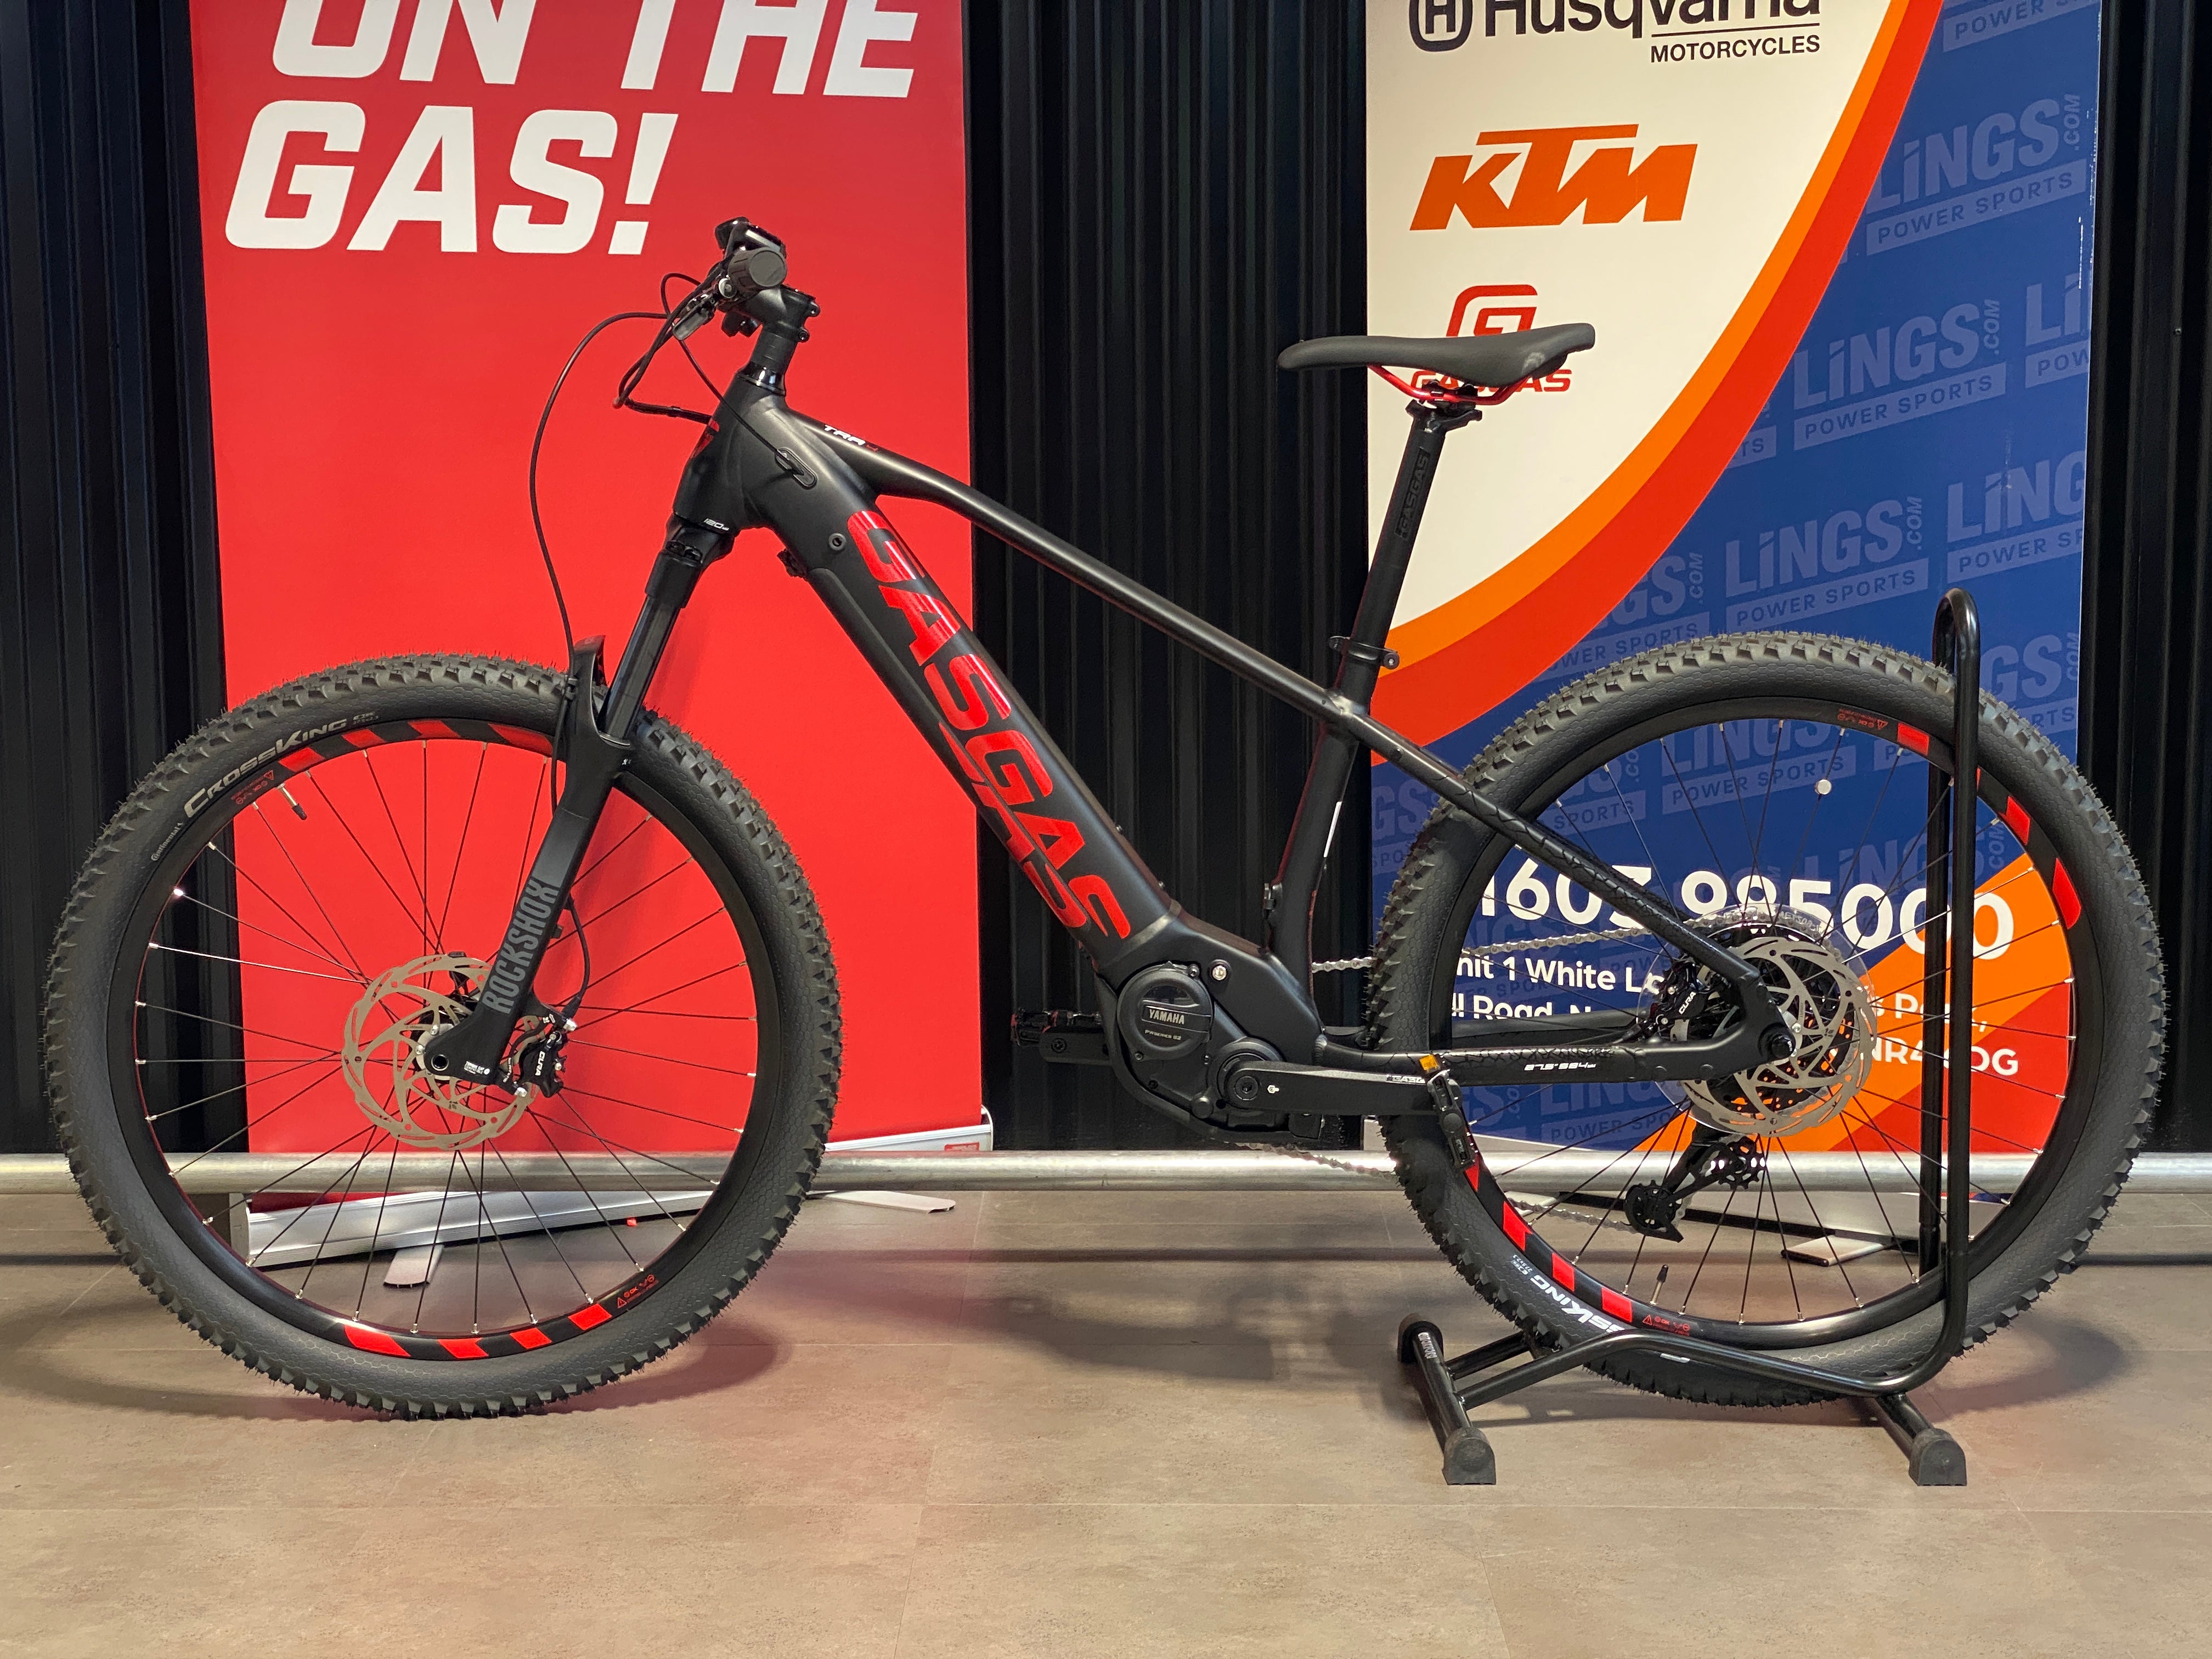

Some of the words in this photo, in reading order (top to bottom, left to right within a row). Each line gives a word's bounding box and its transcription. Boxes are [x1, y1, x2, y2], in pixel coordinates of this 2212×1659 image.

[273, 0, 536, 84] ON
[1651, 35, 1820, 63] MOTORCYCLES
[225, 100, 679, 255] GAS!
[1410, 124, 1698, 231] KTM
[1878, 207, 1964, 244] POWER
[1975, 172, 2073, 213] SPORTS
[1410, 369, 1572, 393] GAAS
[1804, 403, 1888, 439] POWER
[1898, 375, 1993, 414] SPORTS
[1960, 534, 2047, 573] POWER
[1737, 594, 1815, 627] POWER
[1825, 569, 1916, 605] SPORTS
[1616, 622, 1699, 654] SPORTS
[1673, 776, 1748, 805] POWER
[1758, 756, 1844, 787] SPORTS
[1554, 800, 1635, 830] SPORTS
[482, 876, 562, 1014] ROCKSHOX
[1502, 956, 1517, 981] 1
[1525, 957, 1617, 992] White
[1149, 1009, 1185, 1025] YAMAHA
[1678, 990, 1696, 1015] CURA
[535, 1051, 545, 1076] CURA
